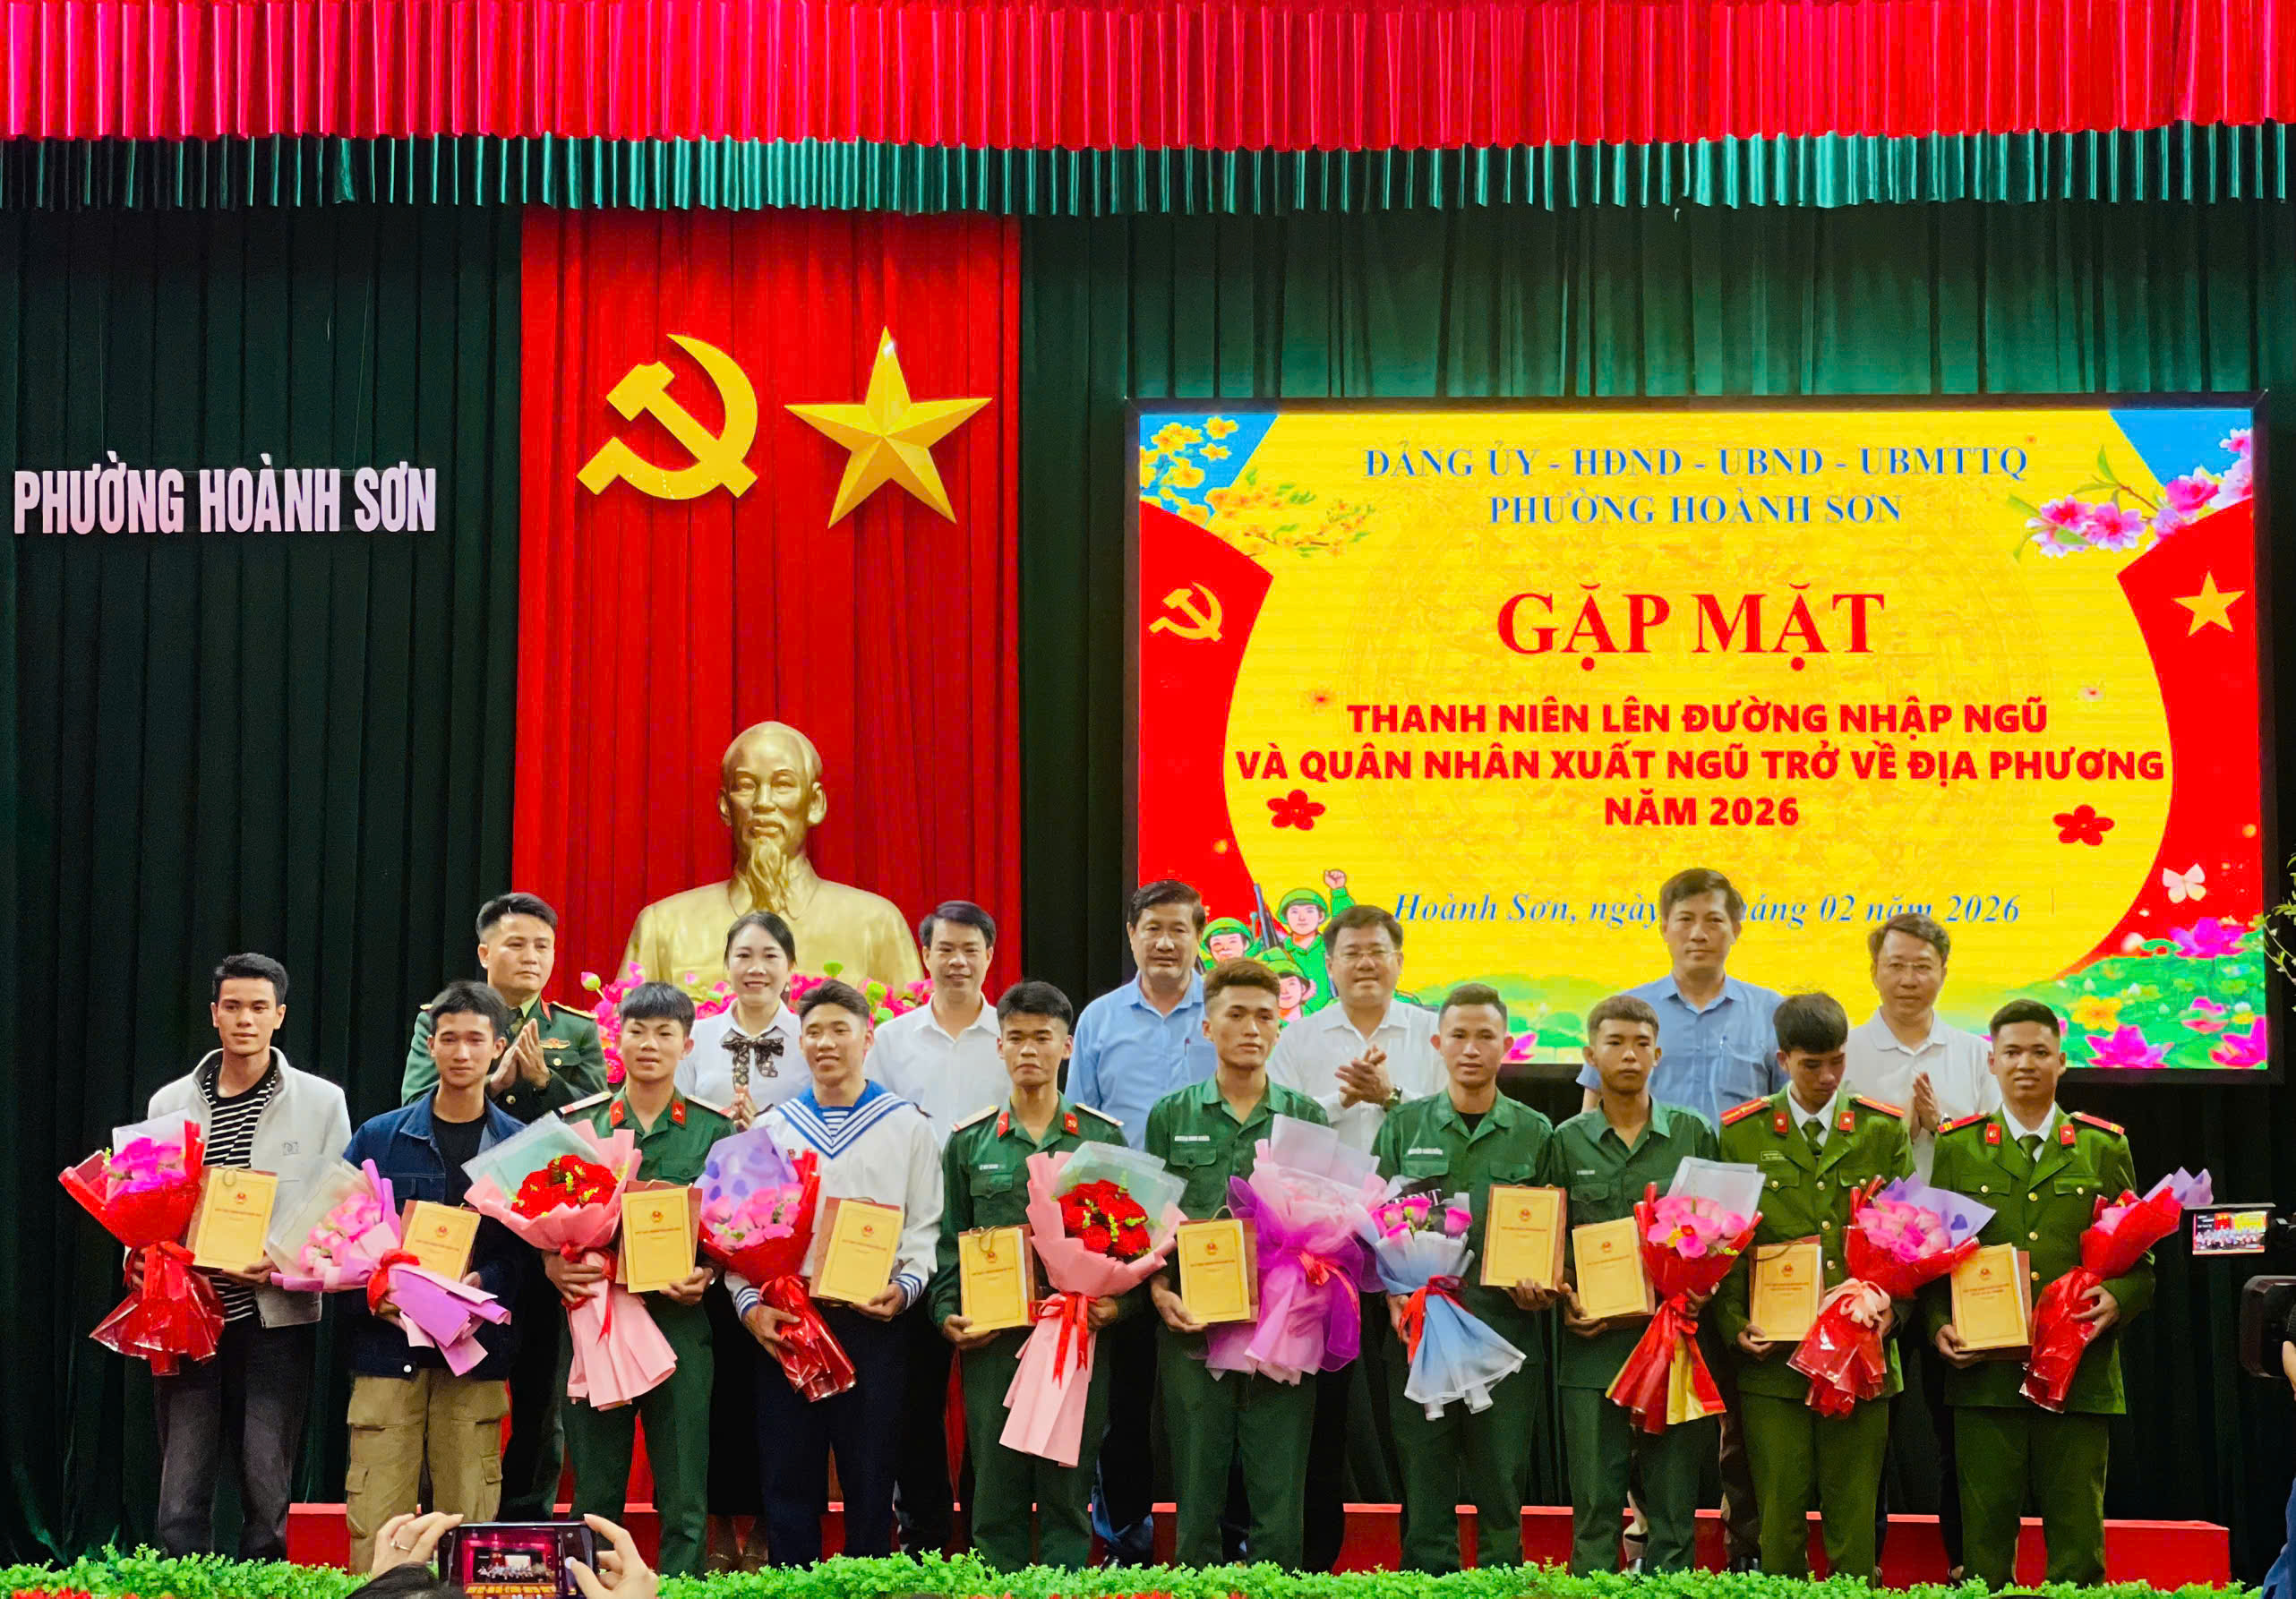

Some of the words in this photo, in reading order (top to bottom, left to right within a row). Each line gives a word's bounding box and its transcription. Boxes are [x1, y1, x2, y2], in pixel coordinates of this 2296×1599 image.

[1362, 440, 1474, 477] ĐẢNG
[1486, 440, 1539, 476] ỦY
[1572, 448, 1683, 476] HĐND
[1717, 447, 1823, 476] UBND
[1859, 446, 2027, 481] UBMTTQ
[14, 450, 184, 534] PHƯỜNG
[200, 453, 340, 533] HOÀNH
[355, 461, 436, 532] SƠN
[1489, 487, 1655, 524] PHƯỜNG
[1669, 486, 1812, 524] HOÀNH
[1825, 493, 1902, 524] SƠN
[1496, 583, 1670, 671] GẶP
[1691, 583, 1885, 671] MẶT
[1346, 705, 1486, 733] THANH
[1498, 696, 1589, 733] NIÊN
[1602, 696, 1670, 733] LÊN
[1681, 696, 1828, 733] ĐƯỜNG
[1839, 696, 1953, 740] NHẬP
[1964, 697, 2047, 733] NGŨ
[1235, 742, 1289, 780] VÀ
[1299, 742, 1412, 782] QUÂN
[1425, 742, 1539, 780] NHÂN
[1550, 740, 1656, 780] XUẤT
[1667, 743, 1749, 780] NGŨ
[1761, 740, 1840, 780] TRỞ
[1849, 740, 1898, 780] VỀ
[1906, 750, 1978, 788] ĐỊA
[1989, 746, 2164, 781] PHƯƠNG
[1605, 788, 1697, 826] NĂM
[1709, 797, 1799, 826] 2026
[1394, 893, 1497, 922] Hoành
[1506, 893, 1577, 926] Sơn,
[1589, 893, 1657, 930] ngày
[1819, 895, 1855, 922] 02
[1945, 894, 2020, 923] 2026
